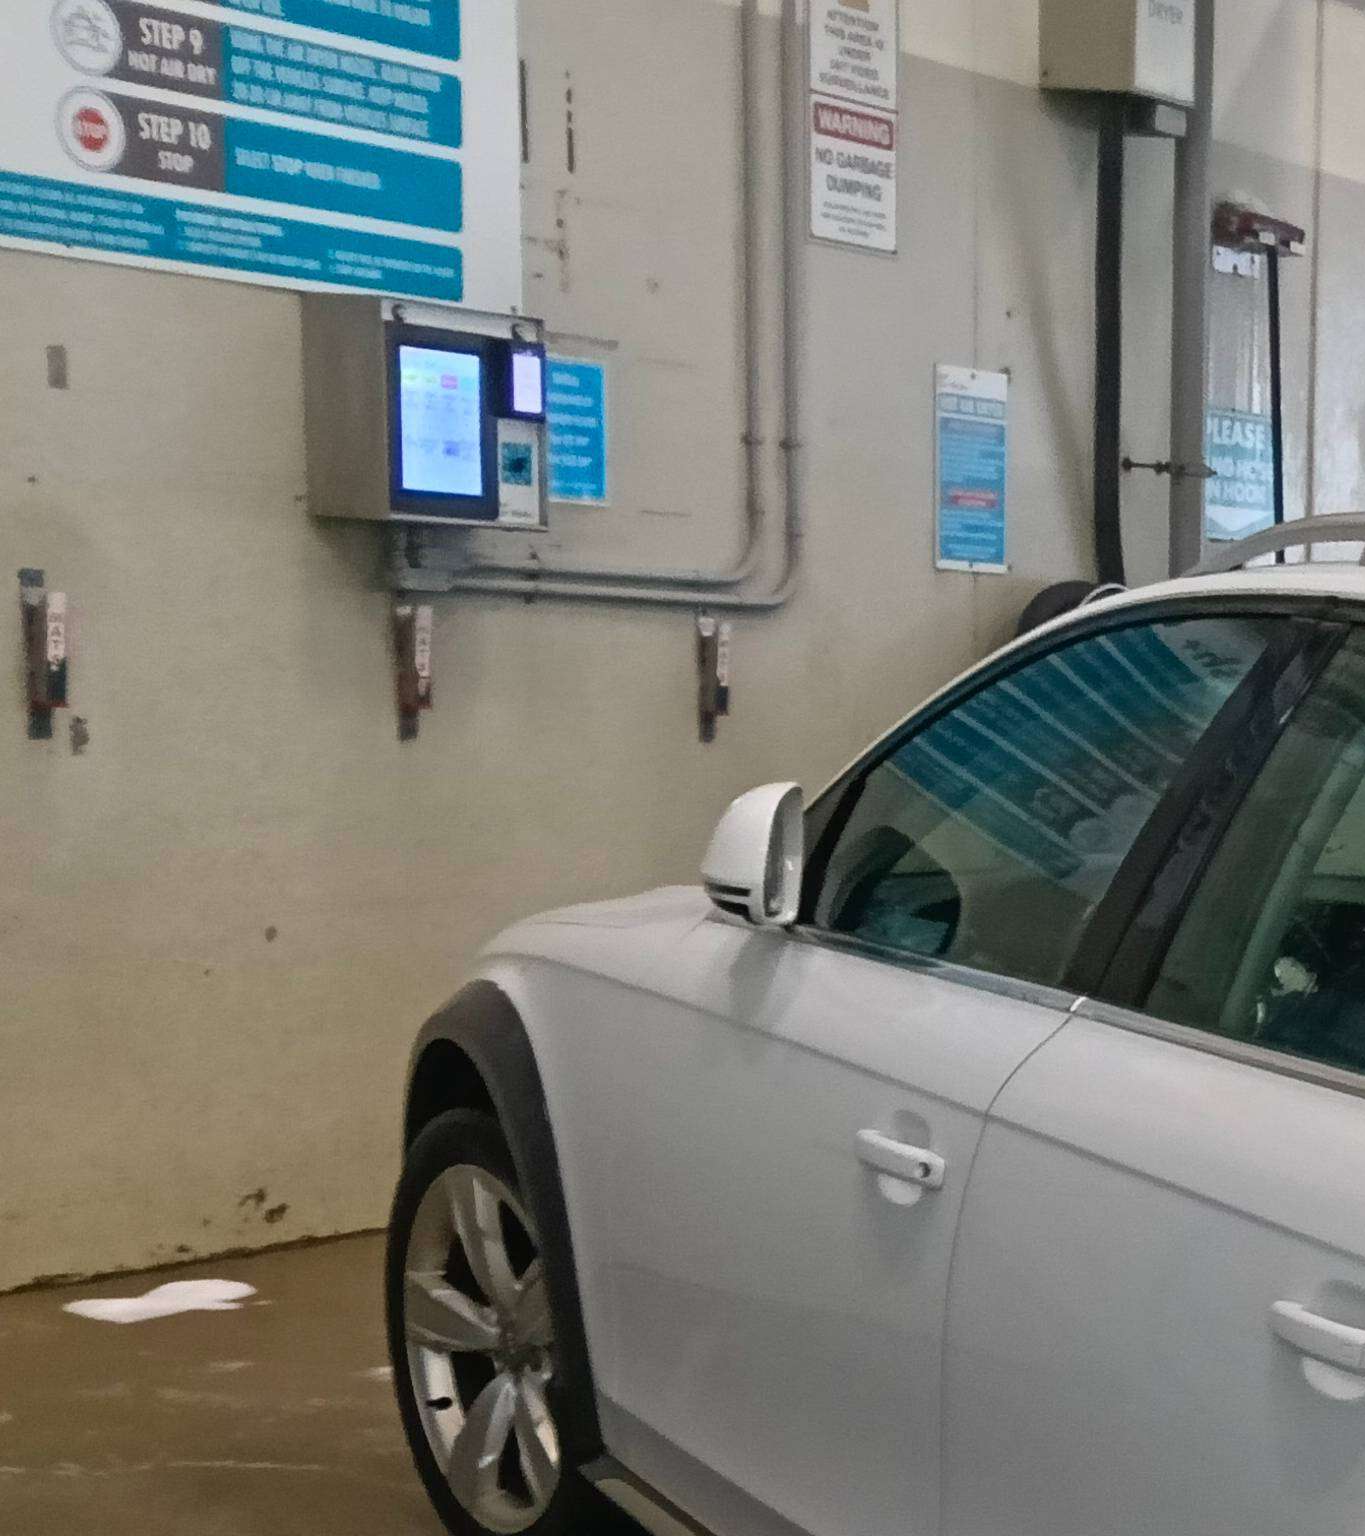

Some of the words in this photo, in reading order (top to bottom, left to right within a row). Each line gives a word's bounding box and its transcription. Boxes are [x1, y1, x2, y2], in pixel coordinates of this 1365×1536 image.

[138, 18, 185, 50] STEP
[189, 28, 203, 54] 9
[138, 112, 183, 144] STEP
[189, 122, 212, 151] 10
[818, 106, 890, 145] WARNING
[157, 151, 195, 172] STOP
[815, 147, 833, 165] NO
[836, 152, 892, 179] GARBAGE
[826, 174, 881, 201] DUMPING
